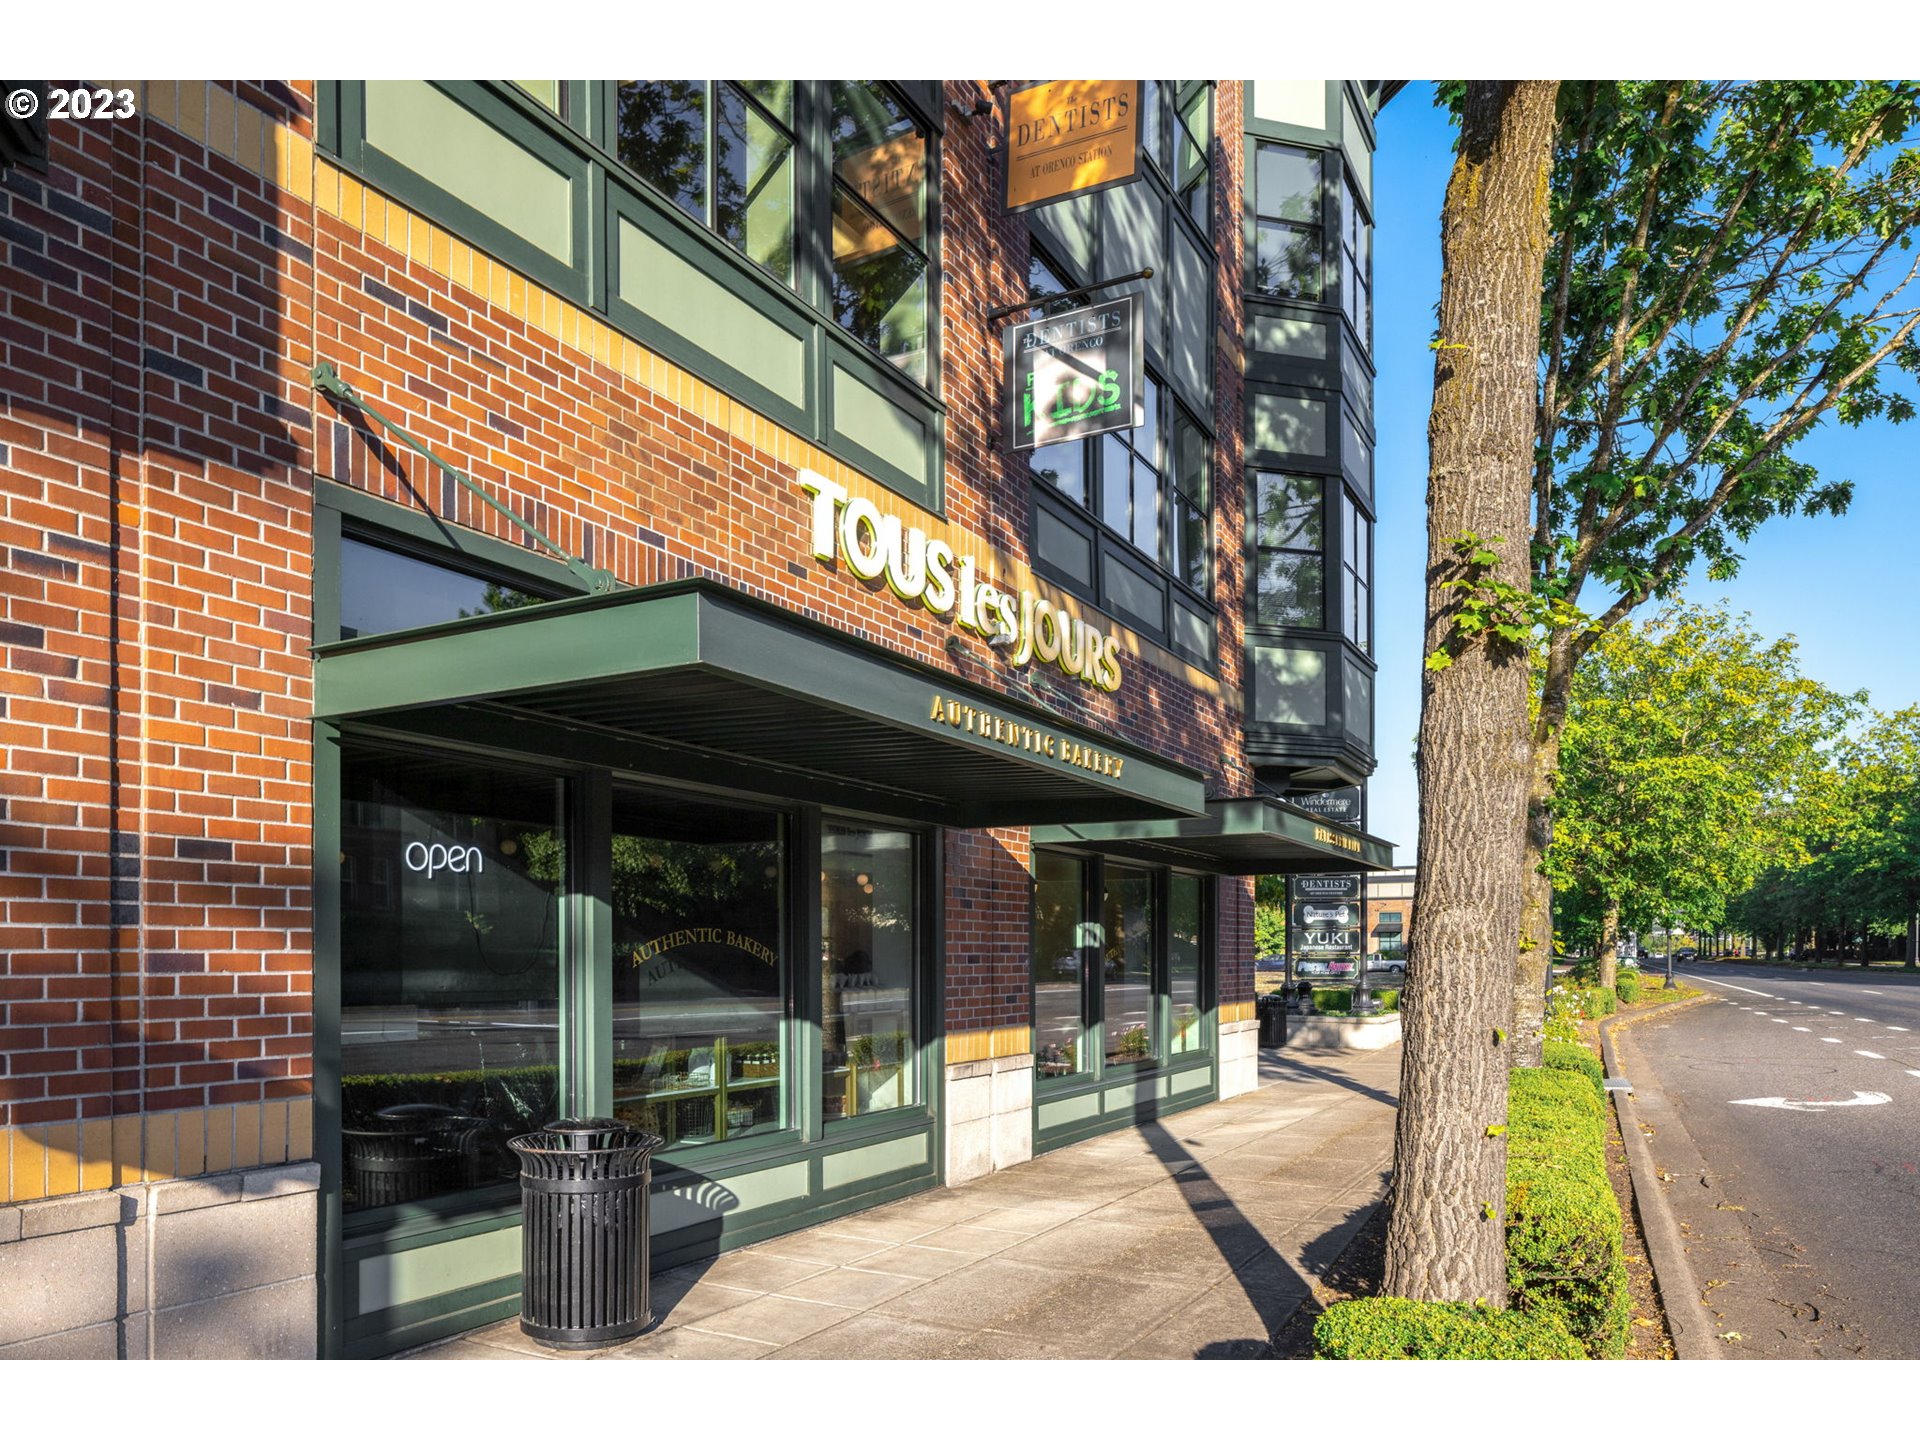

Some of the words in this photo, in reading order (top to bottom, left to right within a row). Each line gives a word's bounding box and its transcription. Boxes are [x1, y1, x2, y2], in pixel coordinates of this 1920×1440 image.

[1017, 93, 1129, 148] DENTISTS
[1030, 165, 1041, 179] AT
[1042, 155, 1076, 174] ORENCO
[1077, 145, 1113, 165] STATION
[1025, 310, 1121, 349] DENTISTS
[1059, 336, 1104, 355] ORENCO
[799, 467, 956, 614] TOUS
[956, 555, 1019, 645] les
[1012, 588, 1122, 692] JOURS
[930, 695, 1055, 758] AUTHENTIC
[1059, 738, 1124, 779] BAKERY
[1302, 880, 1351, 888] DENTISTS
[632, 928, 722, 968] AUTHENTIC
[726, 930, 778, 967] BAKERY
[1304, 932, 1349, 944] YUKI
